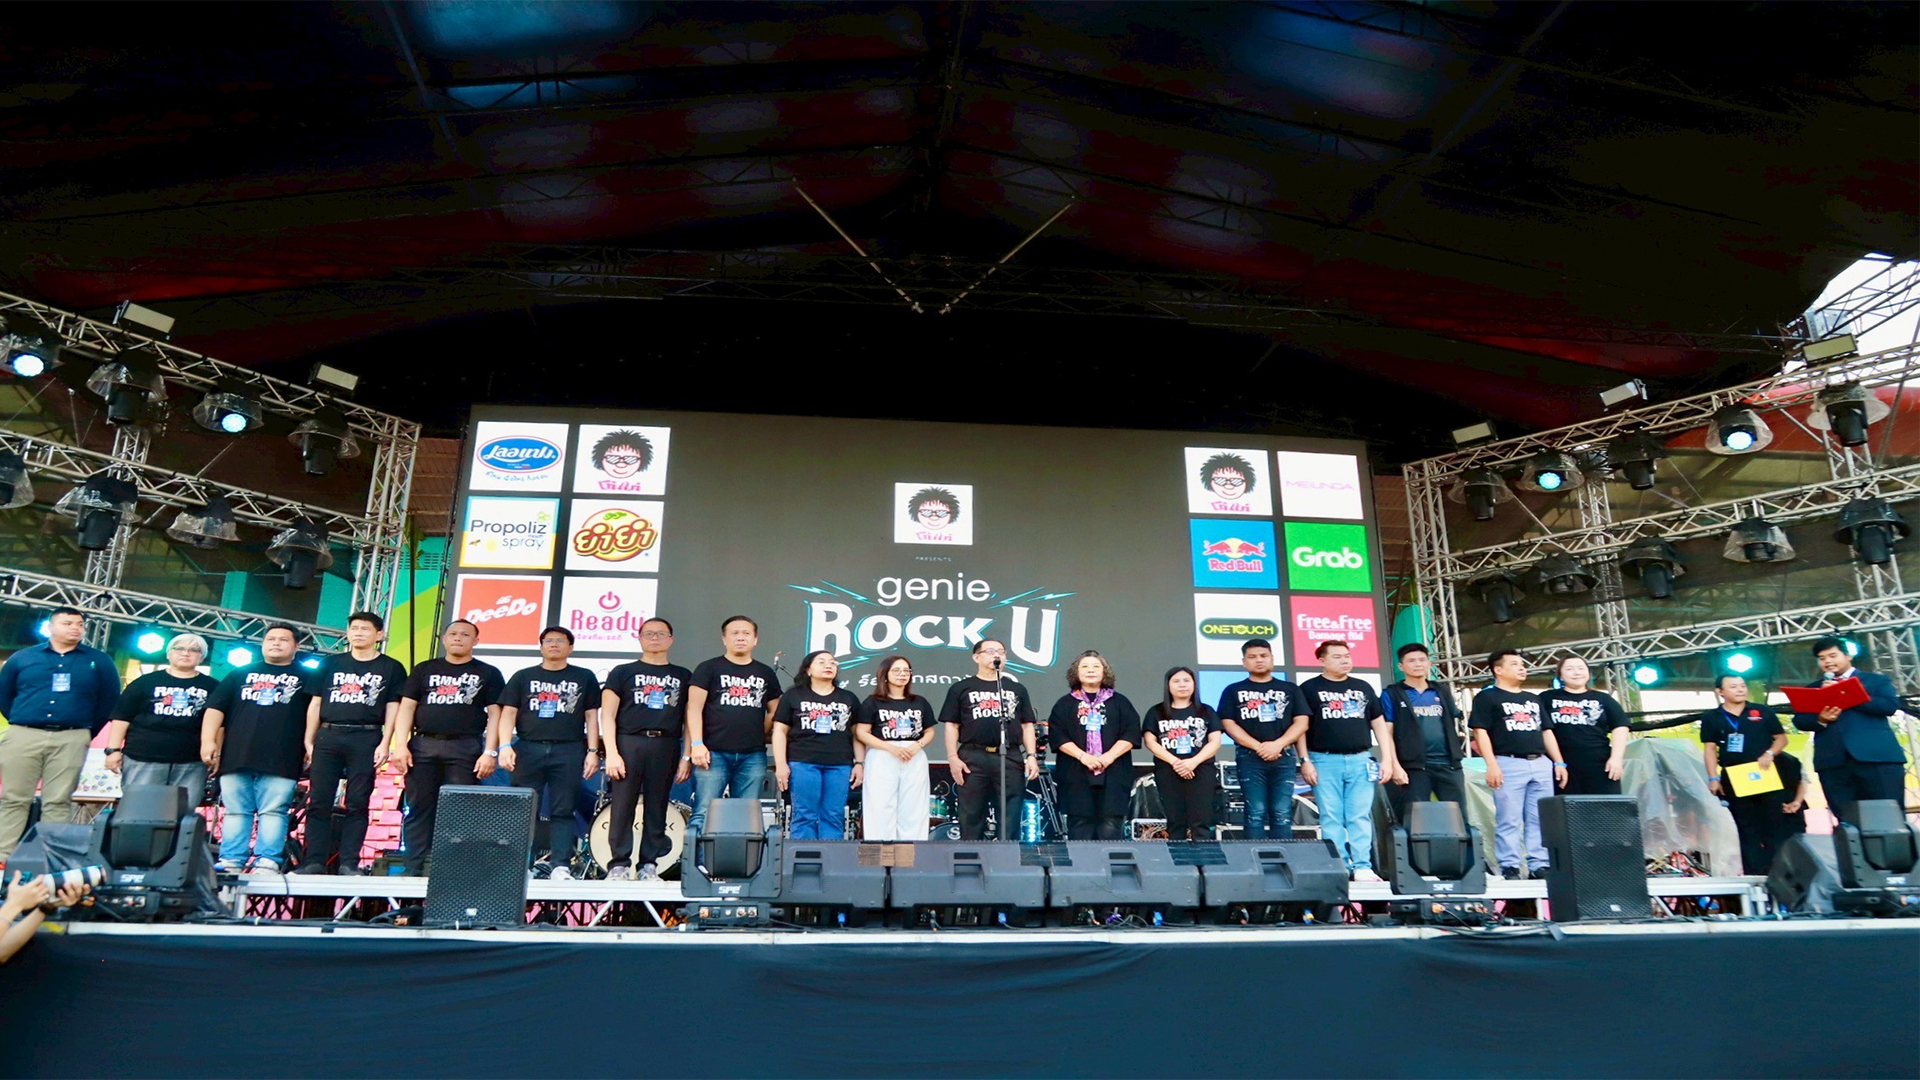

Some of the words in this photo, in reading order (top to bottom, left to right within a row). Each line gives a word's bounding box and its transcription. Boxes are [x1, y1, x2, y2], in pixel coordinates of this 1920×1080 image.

[470, 519, 547, 536] Propoliz
[502, 537, 544, 550] spray
[1208, 558, 1237, 571] Red
[1237, 559, 1263, 572] Bull
[1292, 546, 1363, 569] Grab
[877, 573, 991, 606] genie
[465, 598, 538, 624] DeeDo
[1297, 613, 1372, 630] Free&Free
[570, 609, 644, 639] Ready
[1011, 605, 1059, 667] U
